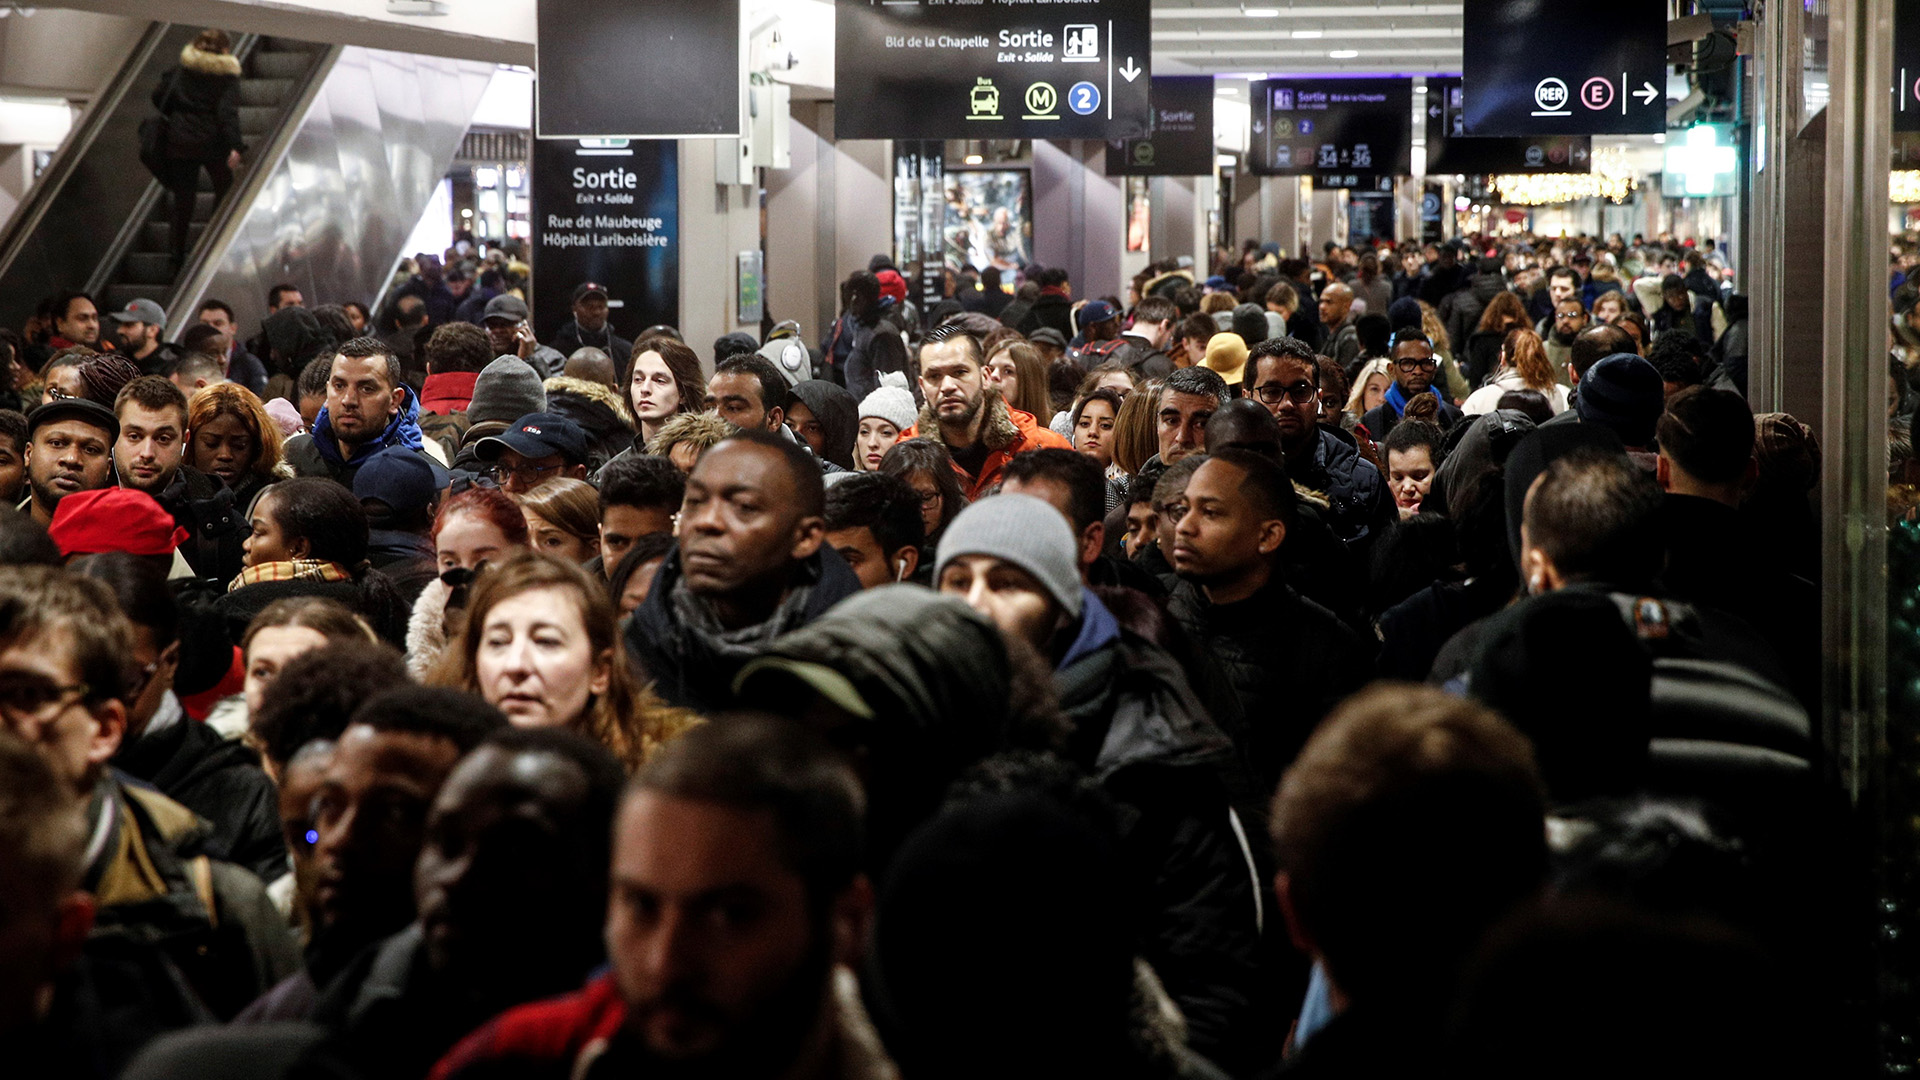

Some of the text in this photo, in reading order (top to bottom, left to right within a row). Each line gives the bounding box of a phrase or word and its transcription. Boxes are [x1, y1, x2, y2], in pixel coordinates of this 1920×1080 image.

[885, 36, 989, 50] Bld de la Chapelle
[998, 29, 1054, 48] Sortie
[997, 52, 1054, 63] Exit Salida
[977, 77, 992, 85] Bus
[1032, 88, 1091, 108] M 2
[1540, 86, 1602, 102] RER E
[1161, 109, 1194, 122] Sortie
[1319, 150, 1338, 165] 34
[1352, 150, 1372, 165] 36
[573, 167, 637, 189] Sortie
[576, 193, 634, 204] Exit Salida
[548, 214, 662, 231] Rue de Maubeuge
[543, 233, 668, 249] Hôpital Lariboisière
